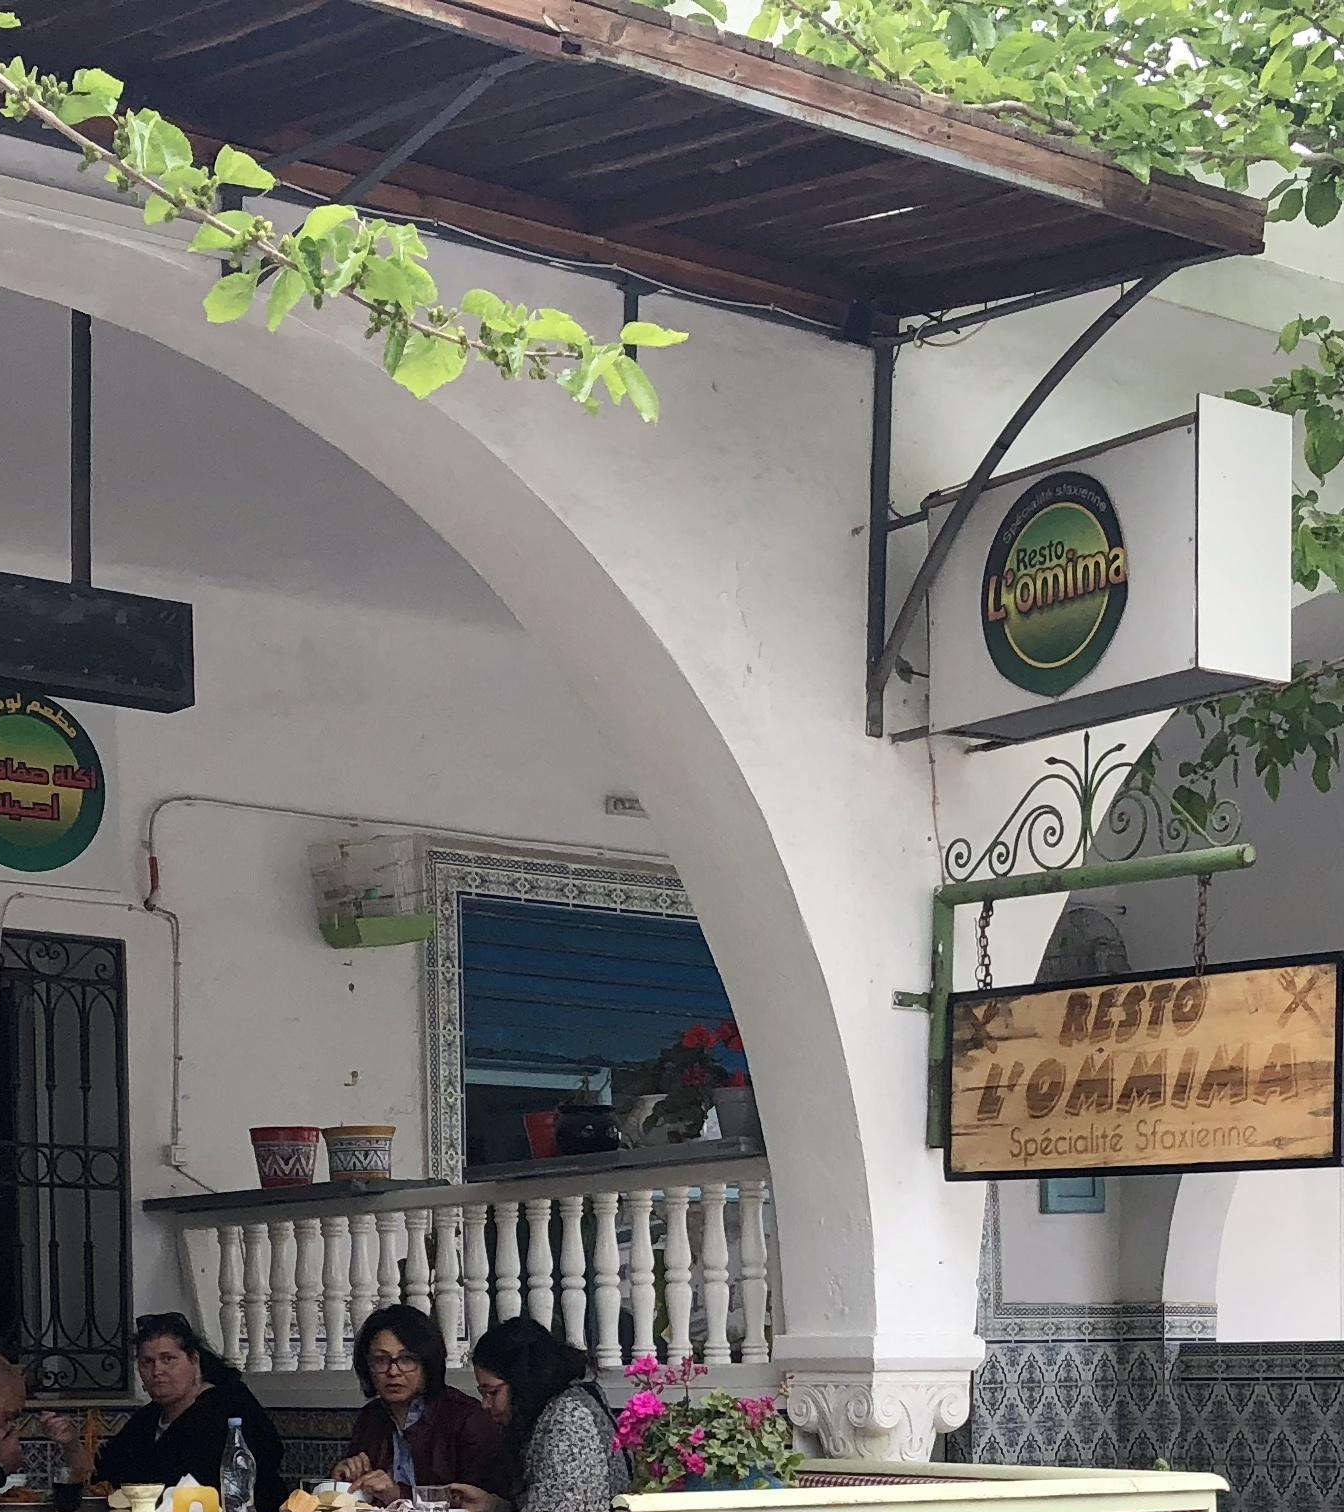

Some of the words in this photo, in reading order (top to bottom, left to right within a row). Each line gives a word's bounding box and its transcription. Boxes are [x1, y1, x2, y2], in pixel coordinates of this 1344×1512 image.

[987, 546, 1128, 622] L'omima
[1016, 540, 1065, 572] Resto
[26, 699, 77, 739] مطعم
[1059, 977, 1209, 1048] RESTO
[976, 1041, 1299, 1122] L'OMMIMA
[1008, 1123, 1124, 1167] Spécialité
[1135, 1119, 1258, 1152] Sfaxienne
